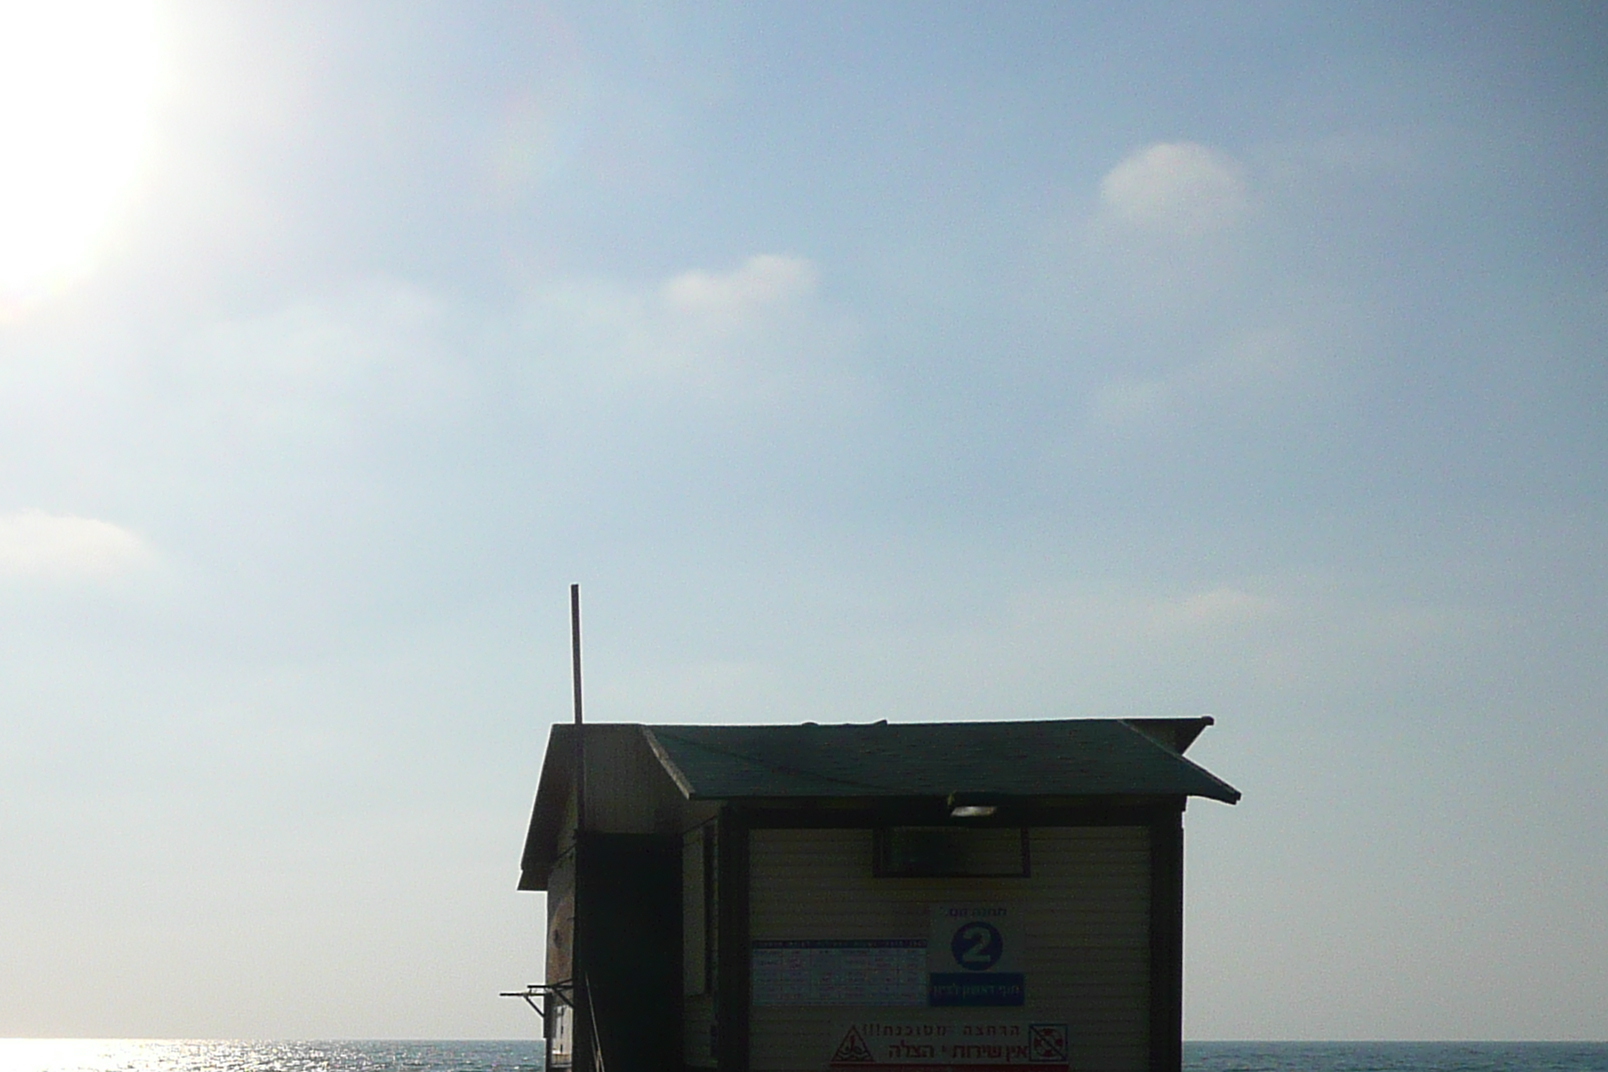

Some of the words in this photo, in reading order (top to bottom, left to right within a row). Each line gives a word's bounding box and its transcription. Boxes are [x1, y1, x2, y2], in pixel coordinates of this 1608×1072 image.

[962, 926, 991, 962] 2
[962, 1025, 1020, 1036] הרחצה
[888, 1039, 935, 1058] הצלה
[1006, 1045, 1029, 1062] אין
